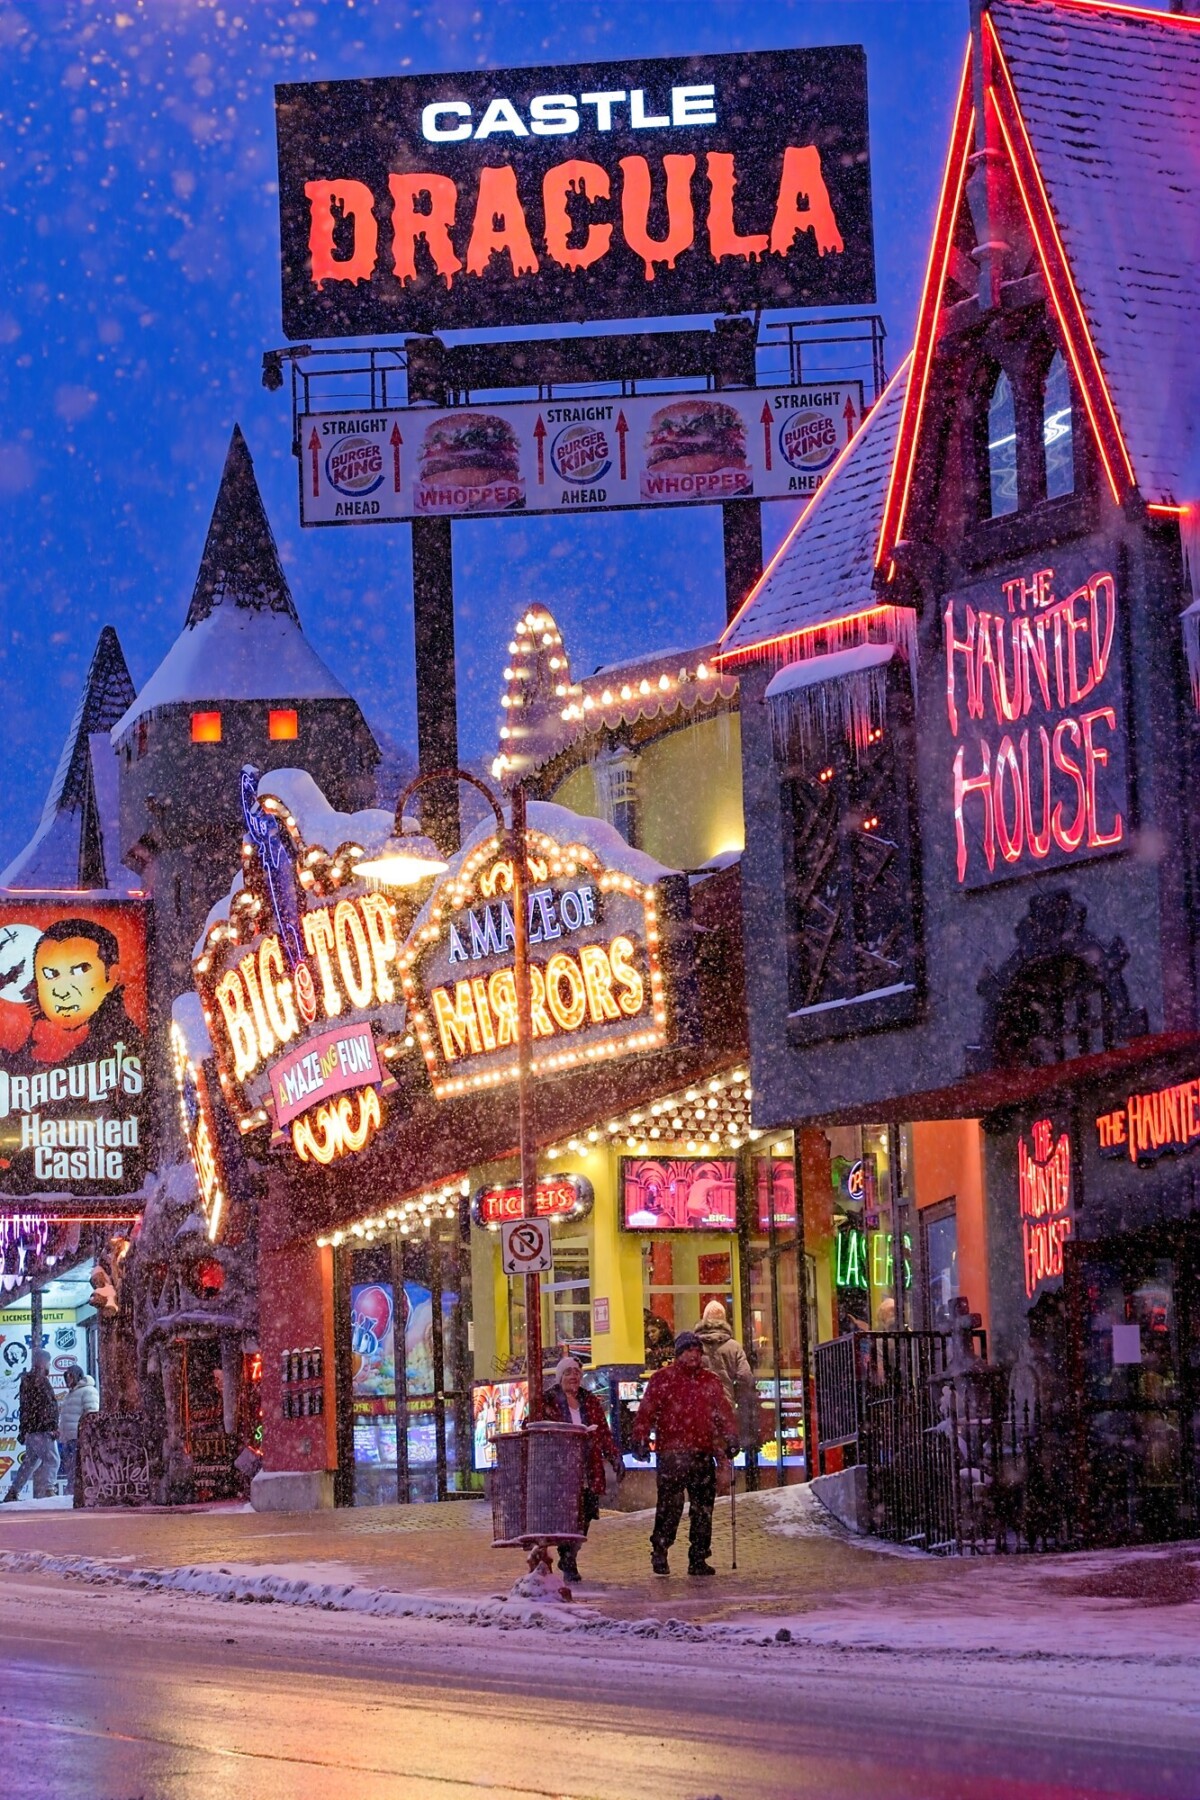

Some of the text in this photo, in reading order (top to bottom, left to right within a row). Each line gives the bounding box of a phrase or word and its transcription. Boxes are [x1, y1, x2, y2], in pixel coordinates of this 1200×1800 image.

[421, 84, 717, 142] CASTLE
[304, 144, 845, 292] DRACULA
[547, 406, 613, 423] STRAIGHT
[775, 392, 840, 409] STRAIGHT
[322, 418, 388, 435] STRAIGHT
[784, 418, 834, 446] BURGER
[331, 444, 380, 469] BURGER
[557, 431, 605, 460] BURGER
[560, 442, 609, 475] KING
[788, 428, 837, 461] KING
[333, 457, 383, 485] KING
[646, 473, 748, 494] WHOPPER
[788, 475, 825, 491] AHEA
[335, 501, 380, 517] AHEAD
[420, 486, 521, 507] WHOPPER
[561, 489, 607, 504] AHEAD
[1002, 568, 1055, 613] THE
[944, 571, 1115, 737] HAUNTED
[953, 706, 1123, 884] HOUSE
[449, 922, 468, 964] A
[560, 886, 595, 932] OF
[215, 892, 397, 1082] BIG TOP
[336, 1034, 372, 1077] FUN!
[20, 1113, 139, 1151] Haunted
[1096, 1078, 1200, 1163] THE HAUNTE
[1032, 1119, 1053, 1162] THE
[34, 1145, 123, 1179] Castle
[1018, 1133, 1070, 1218] HAUNTED
[487, 1188, 567, 1216] TICETS
[2, 1314, 33, 1323] LICENSE
[84, 1481, 149, 1500] CASTLE
